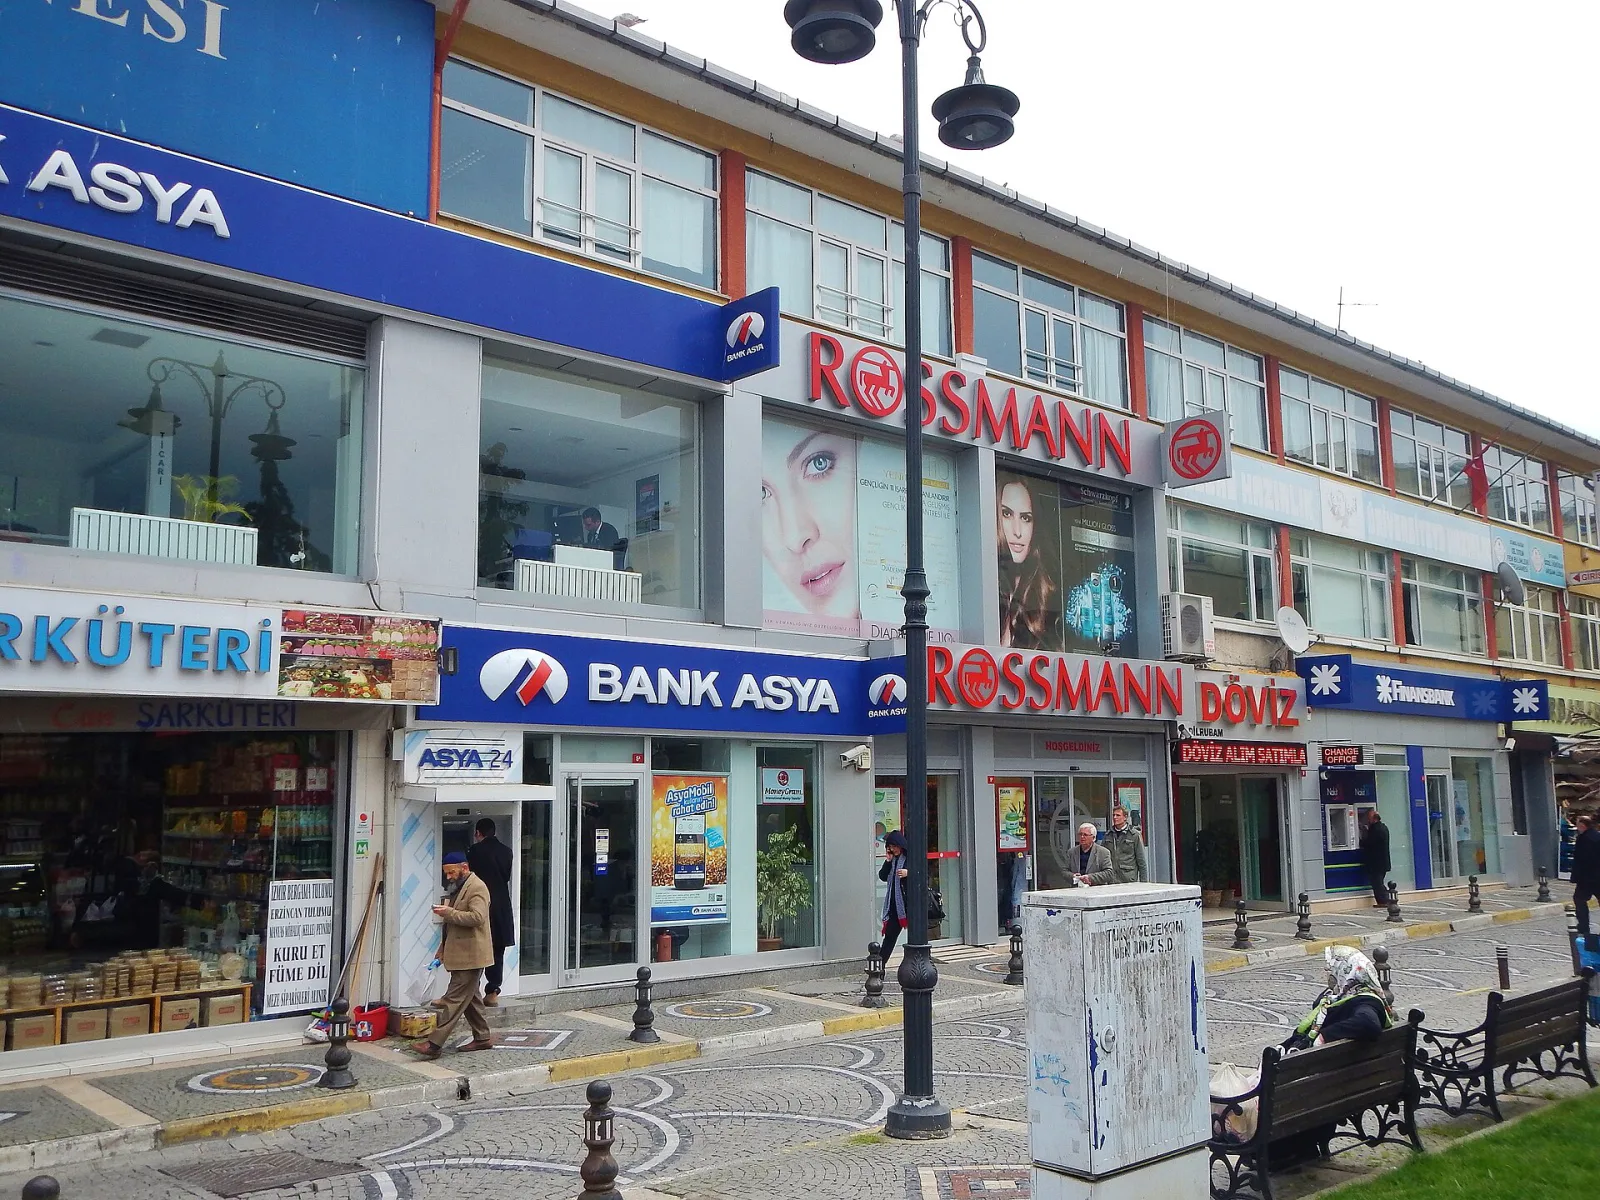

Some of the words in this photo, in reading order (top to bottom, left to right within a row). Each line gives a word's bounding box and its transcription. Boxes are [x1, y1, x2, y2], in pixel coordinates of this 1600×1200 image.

[29, 149, 230, 238] ASYA
[727, 349, 746, 362] BANK
[746, 343, 764, 356] ASYA
[1080, 486, 1119, 503] Schwarzkopf
[588, 662, 723, 708] BANK
[731, 672, 840, 714] ASYA
[927, 646, 1182, 717] ROSSMANN
[1197, 674, 1299, 727] DÖVİZ
[868, 709, 890, 718] BANK
[418, 748, 483, 768] ASYA
[490, 749, 513, 768] 24
[1182, 740, 1224, 763] DÖVİZ
[1226, 745, 1256, 764] ALIM
[1324, 747, 1359, 756] CHANGE
[1327, 755, 1358, 764] OFFICE
[666, 781, 713, 803] AsyaMobil
[764, 787, 803, 797] MoneyGram
[672, 803, 696, 816] rahat
[695, 797, 715, 812] edin!
[270, 905, 302, 920] ERZİNCAN
[304, 905, 332, 918] TULUMU
[273, 945, 307, 962] KURU
[311, 944, 326, 959] ET
[268, 964, 304, 983] FÜME
[308, 962, 328, 980] DİL
